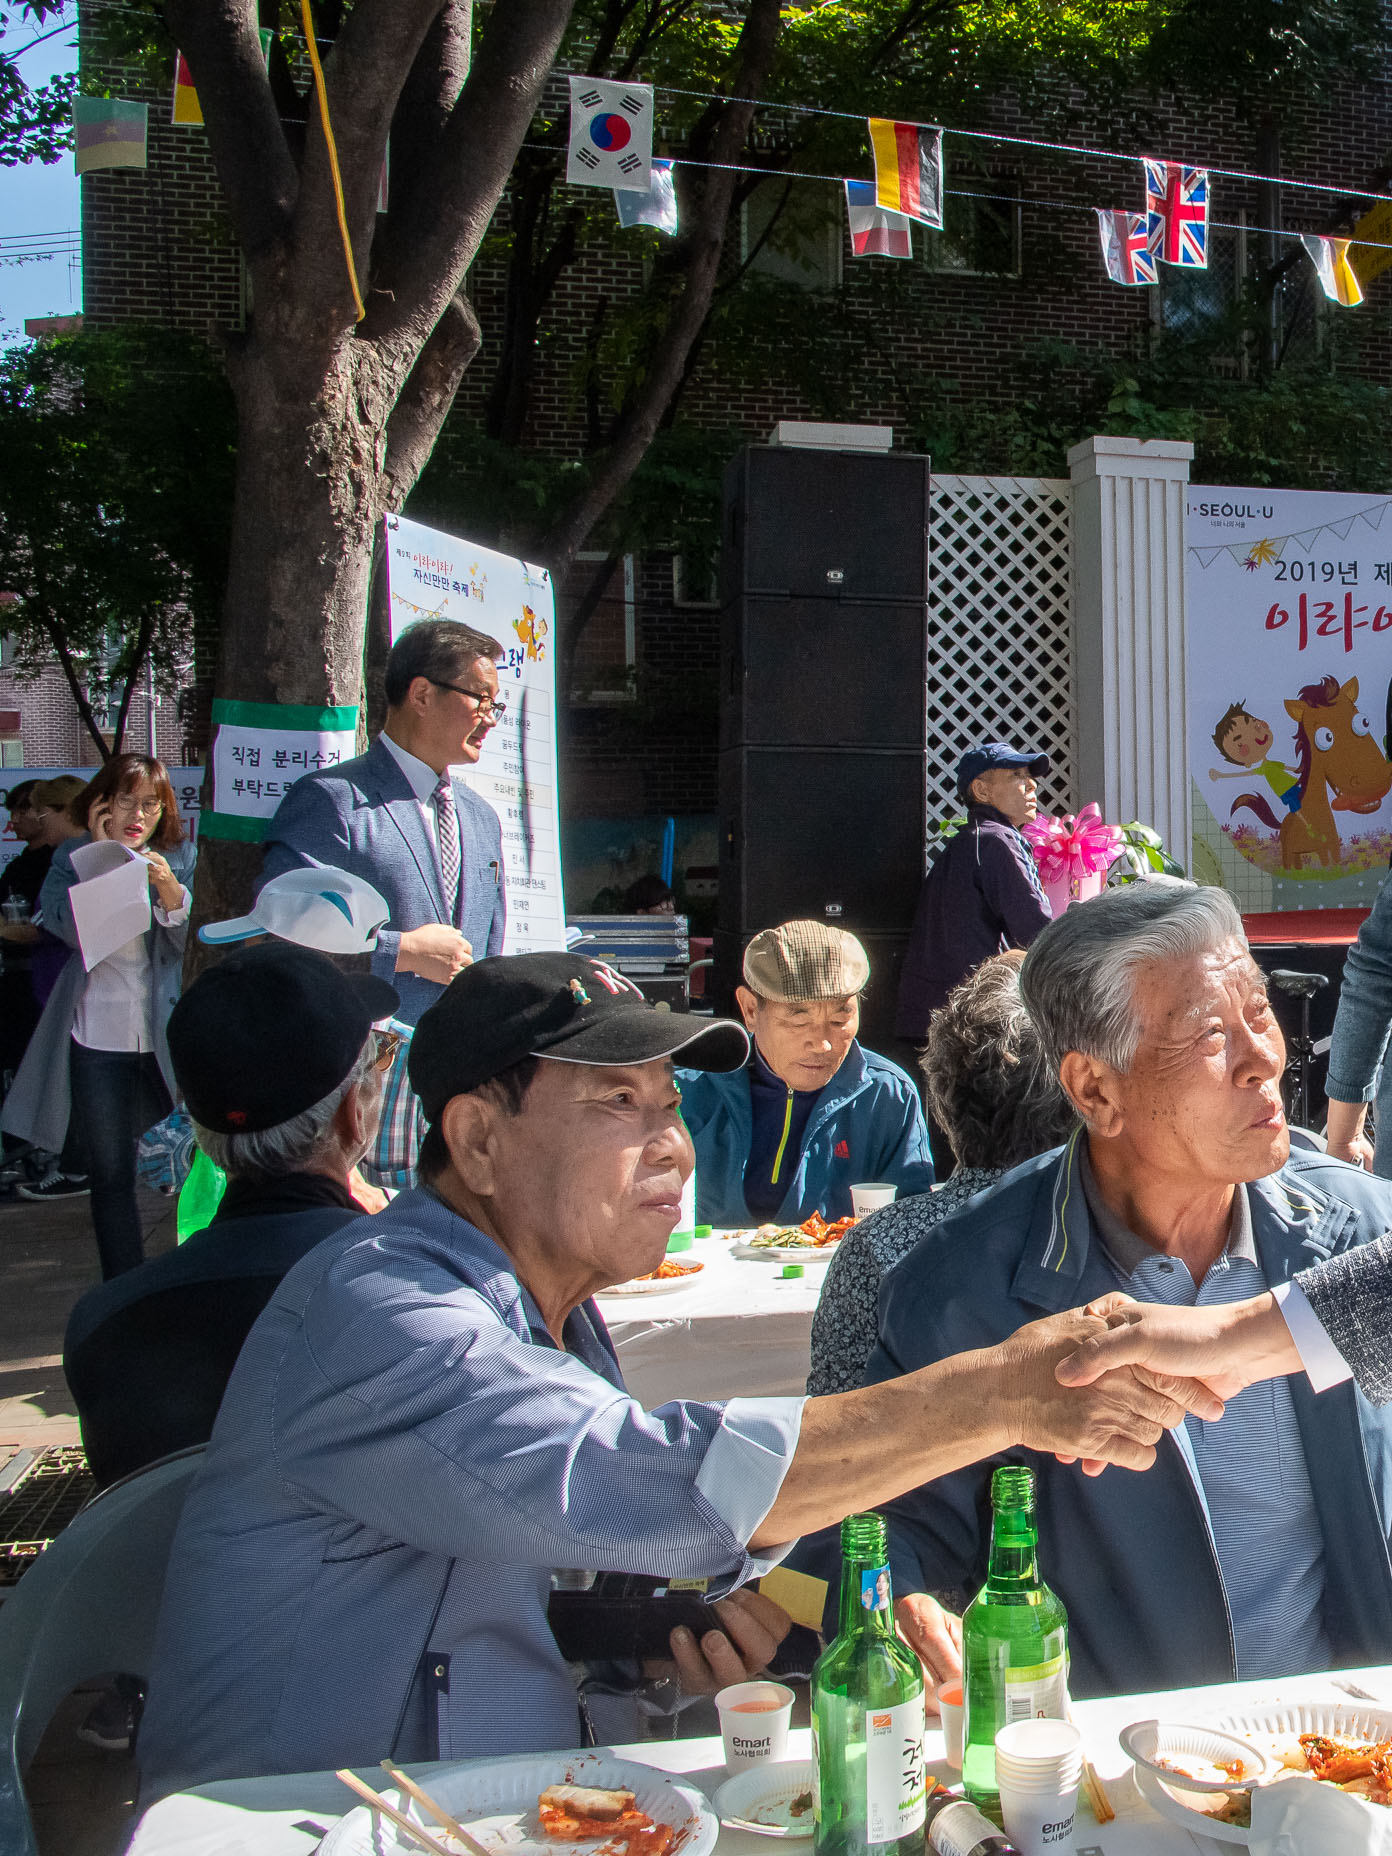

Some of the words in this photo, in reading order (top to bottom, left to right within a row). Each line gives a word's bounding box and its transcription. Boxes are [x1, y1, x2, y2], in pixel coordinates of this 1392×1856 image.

[413, 568, 450, 592] 자신만만
[452, 580, 470, 598] 축제
[1274, 561, 1358, 586] 2019년
[232, 746, 261, 767] 직접
[272, 749, 340, 769] 분리수거
[732, 1736, 772, 1749] emart
[734, 1748, 771, 1758] 노사협의회
